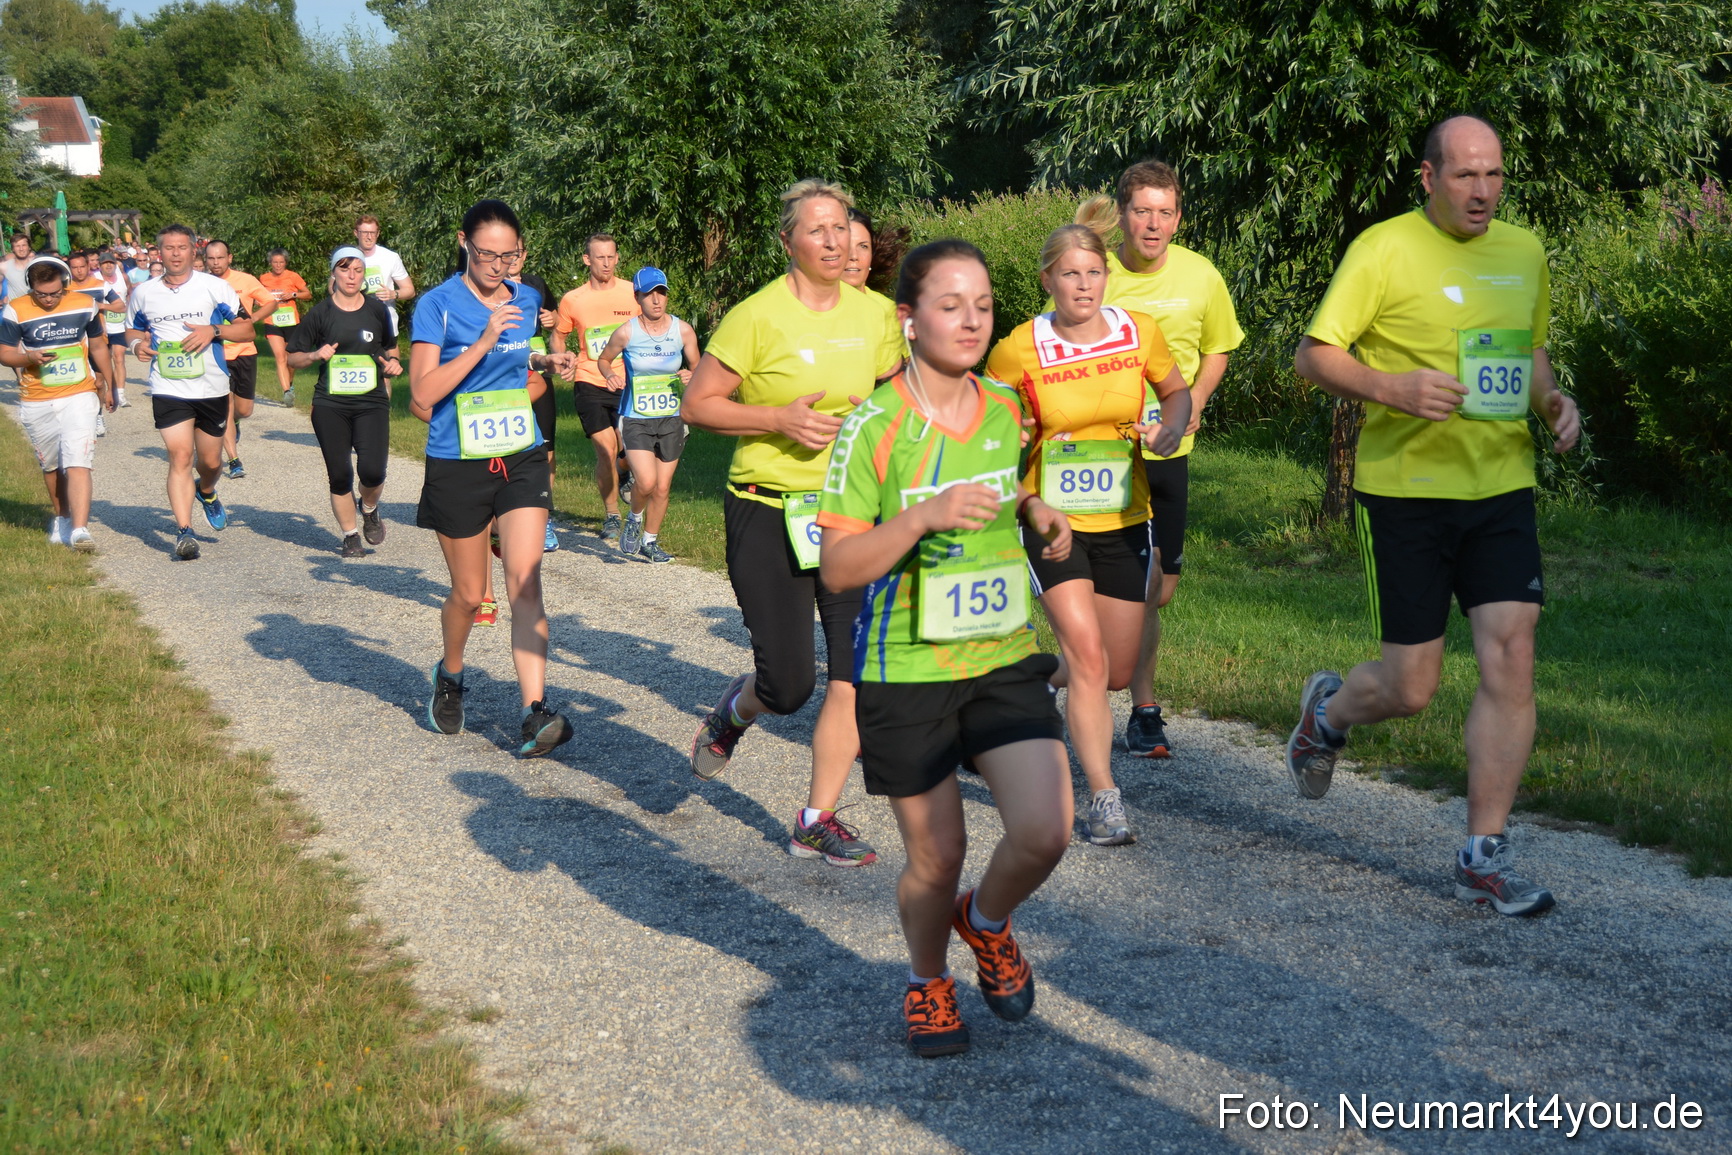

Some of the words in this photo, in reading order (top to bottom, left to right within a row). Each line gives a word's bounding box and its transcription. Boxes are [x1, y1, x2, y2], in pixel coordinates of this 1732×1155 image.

[153, 311, 204, 324] DELPHI
[276, 313, 291, 322] 621
[41, 325, 80, 339] Fischer
[49, 361, 77, 376] 454
[167, 355, 193, 368] 281
[339, 370, 367, 384] 325
[1042, 366, 1091, 385] MAX
[1096, 356, 1142, 375] BÖGL
[1478, 365, 1522, 395] 636
[637, 393, 679, 411] 5195
[468, 415, 527, 441] 1313
[823, 398, 885, 495] BOCK
[1059, 468, 1114, 493] 890
[946, 577, 1008, 618] 153
[953, 624, 979, 633] Daniela
